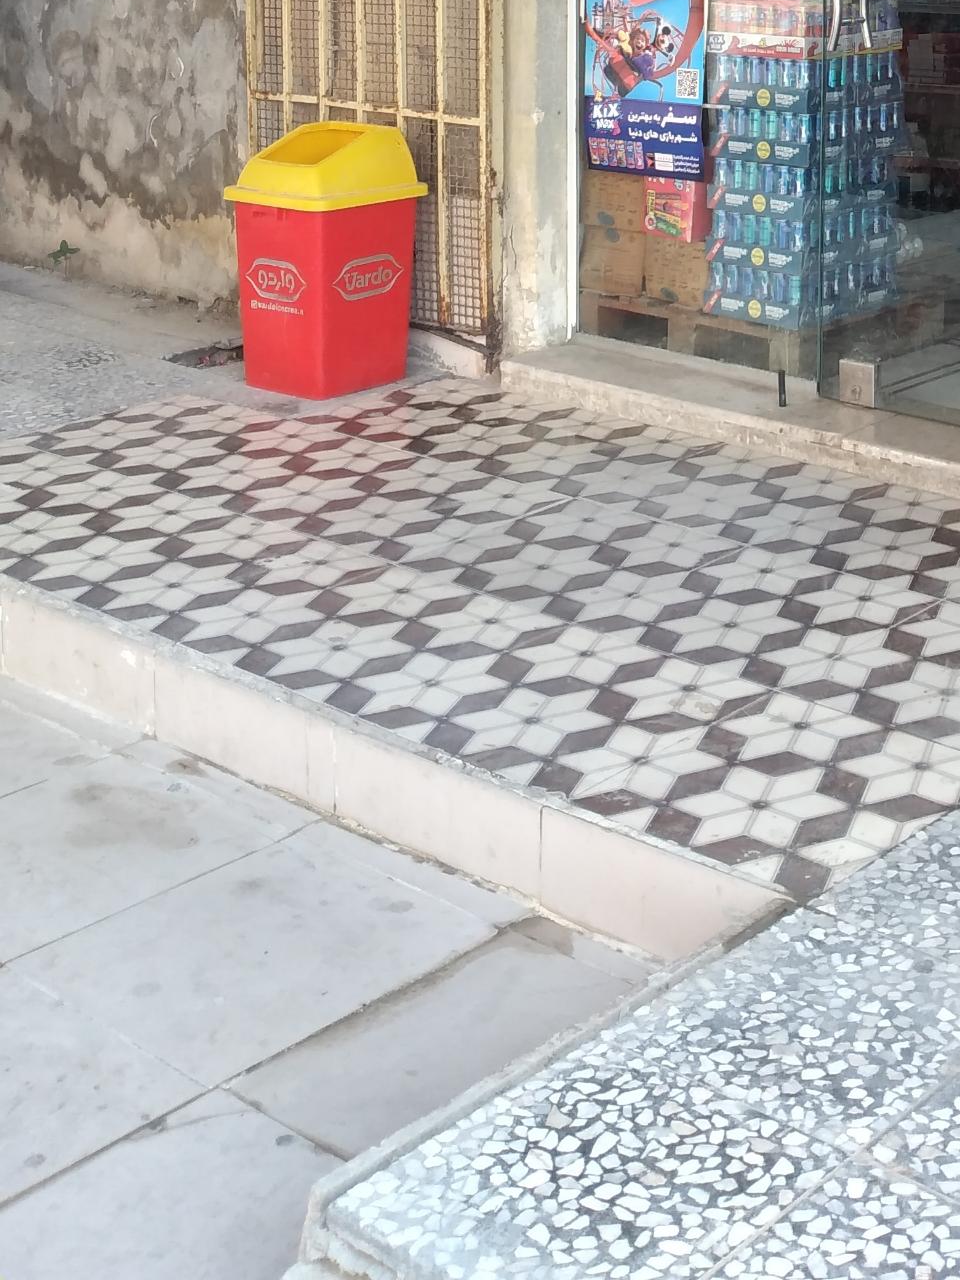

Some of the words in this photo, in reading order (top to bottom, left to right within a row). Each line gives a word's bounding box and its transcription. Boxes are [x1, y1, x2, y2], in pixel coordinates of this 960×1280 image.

[627, 111, 651, 124] بهترین
[650, 114, 661, 125] به
[660, 106, 697, 128] سفر
[627, 127, 643, 139] دنیا
[642, 129, 658, 140] های
[342, 266, 393, 290] Vardo
